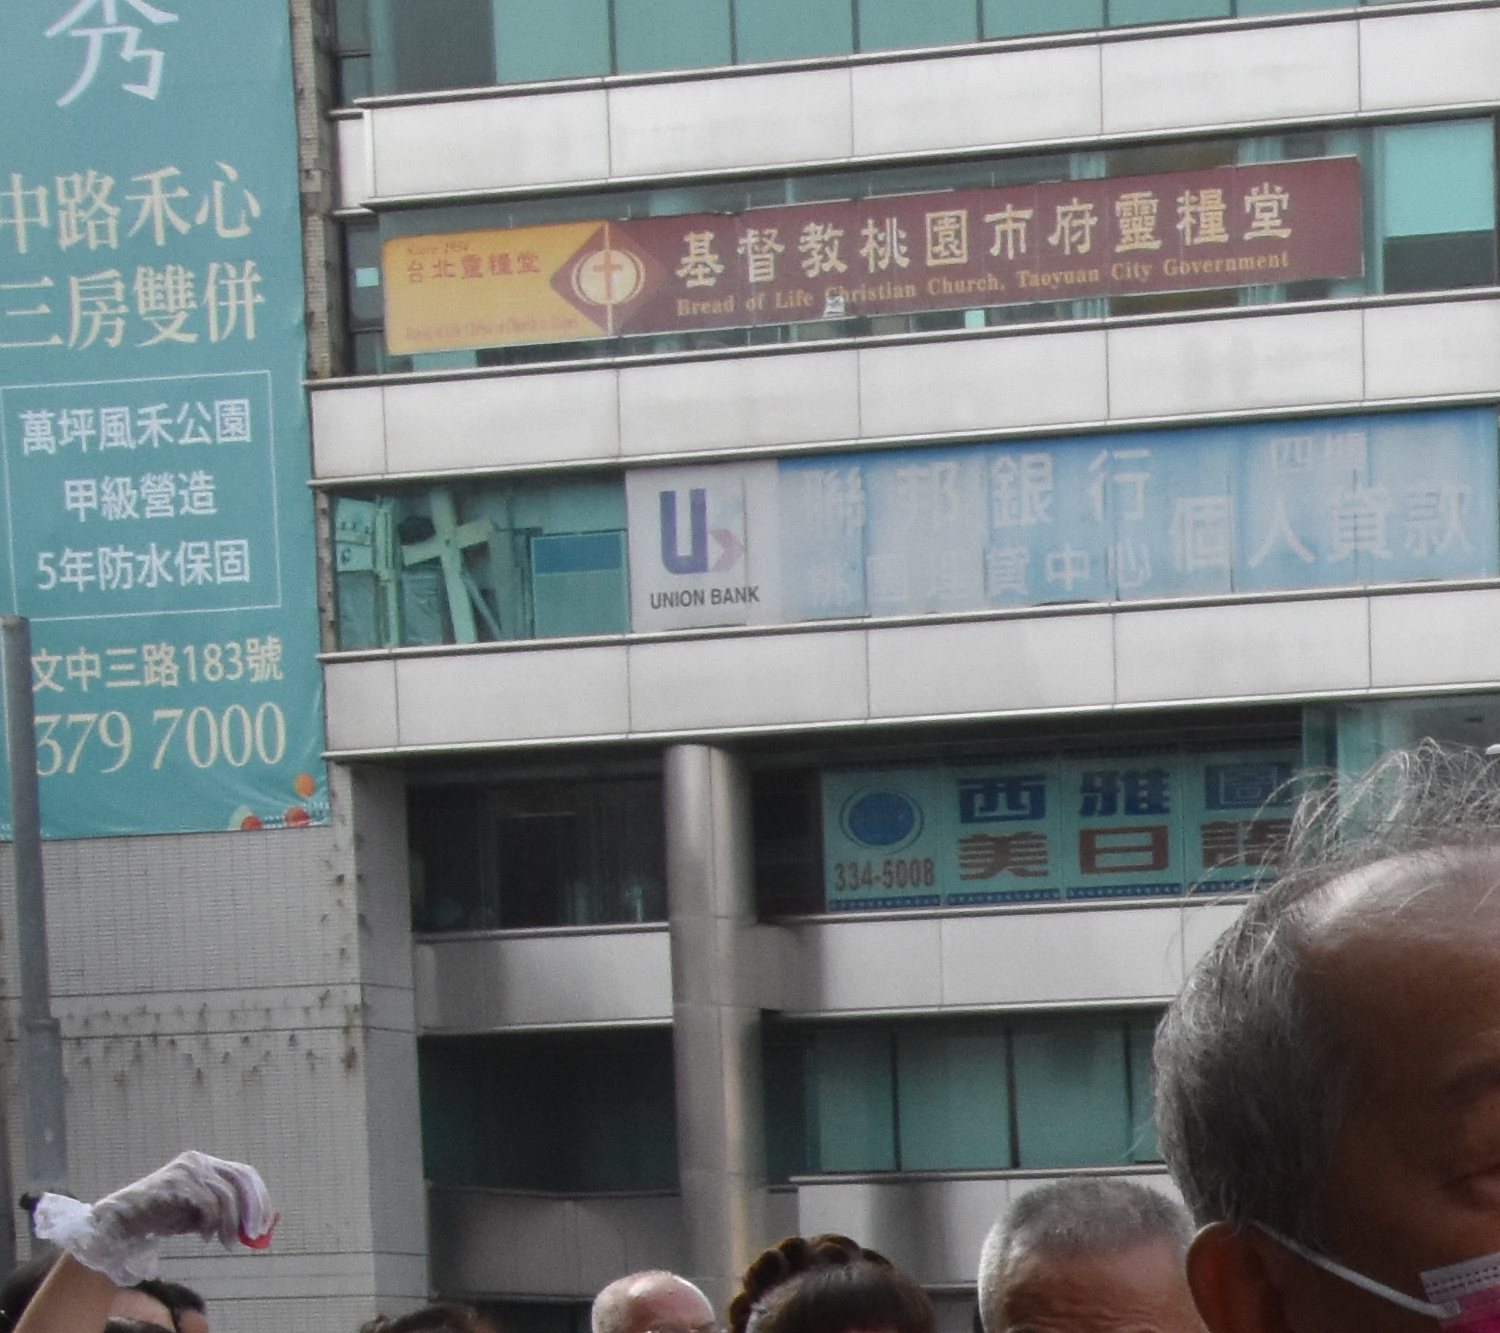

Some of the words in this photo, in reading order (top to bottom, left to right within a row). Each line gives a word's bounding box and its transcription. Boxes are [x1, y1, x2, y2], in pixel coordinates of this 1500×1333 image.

[0, 161, 262, 255] 中路禾心
[675, 181, 1293, 290] 基督教桃園市府靈糧堂
[0, 261, 266, 352] 三房雙併
[677, 296, 735, 317] Bread
[745, 293, 767, 312] of
[775, 289, 813, 312] Life
[824, 281, 917, 308] Christian
[1017, 266, 1100, 291] Taoyuan
[1110, 262, 1153, 285] City
[1162, 251, 1291, 277] Government
[21, 399, 252, 455] 萬坪風禾公園
[64, 469, 217, 523] 甲級營造
[38, 538, 251, 592] 5年防水保固
[650, 589, 704, 611] UNION
[711, 584, 761, 607] BANK
[31, 636, 284, 693] 文中三路183號
[150, 701, 288, 769] 7000
